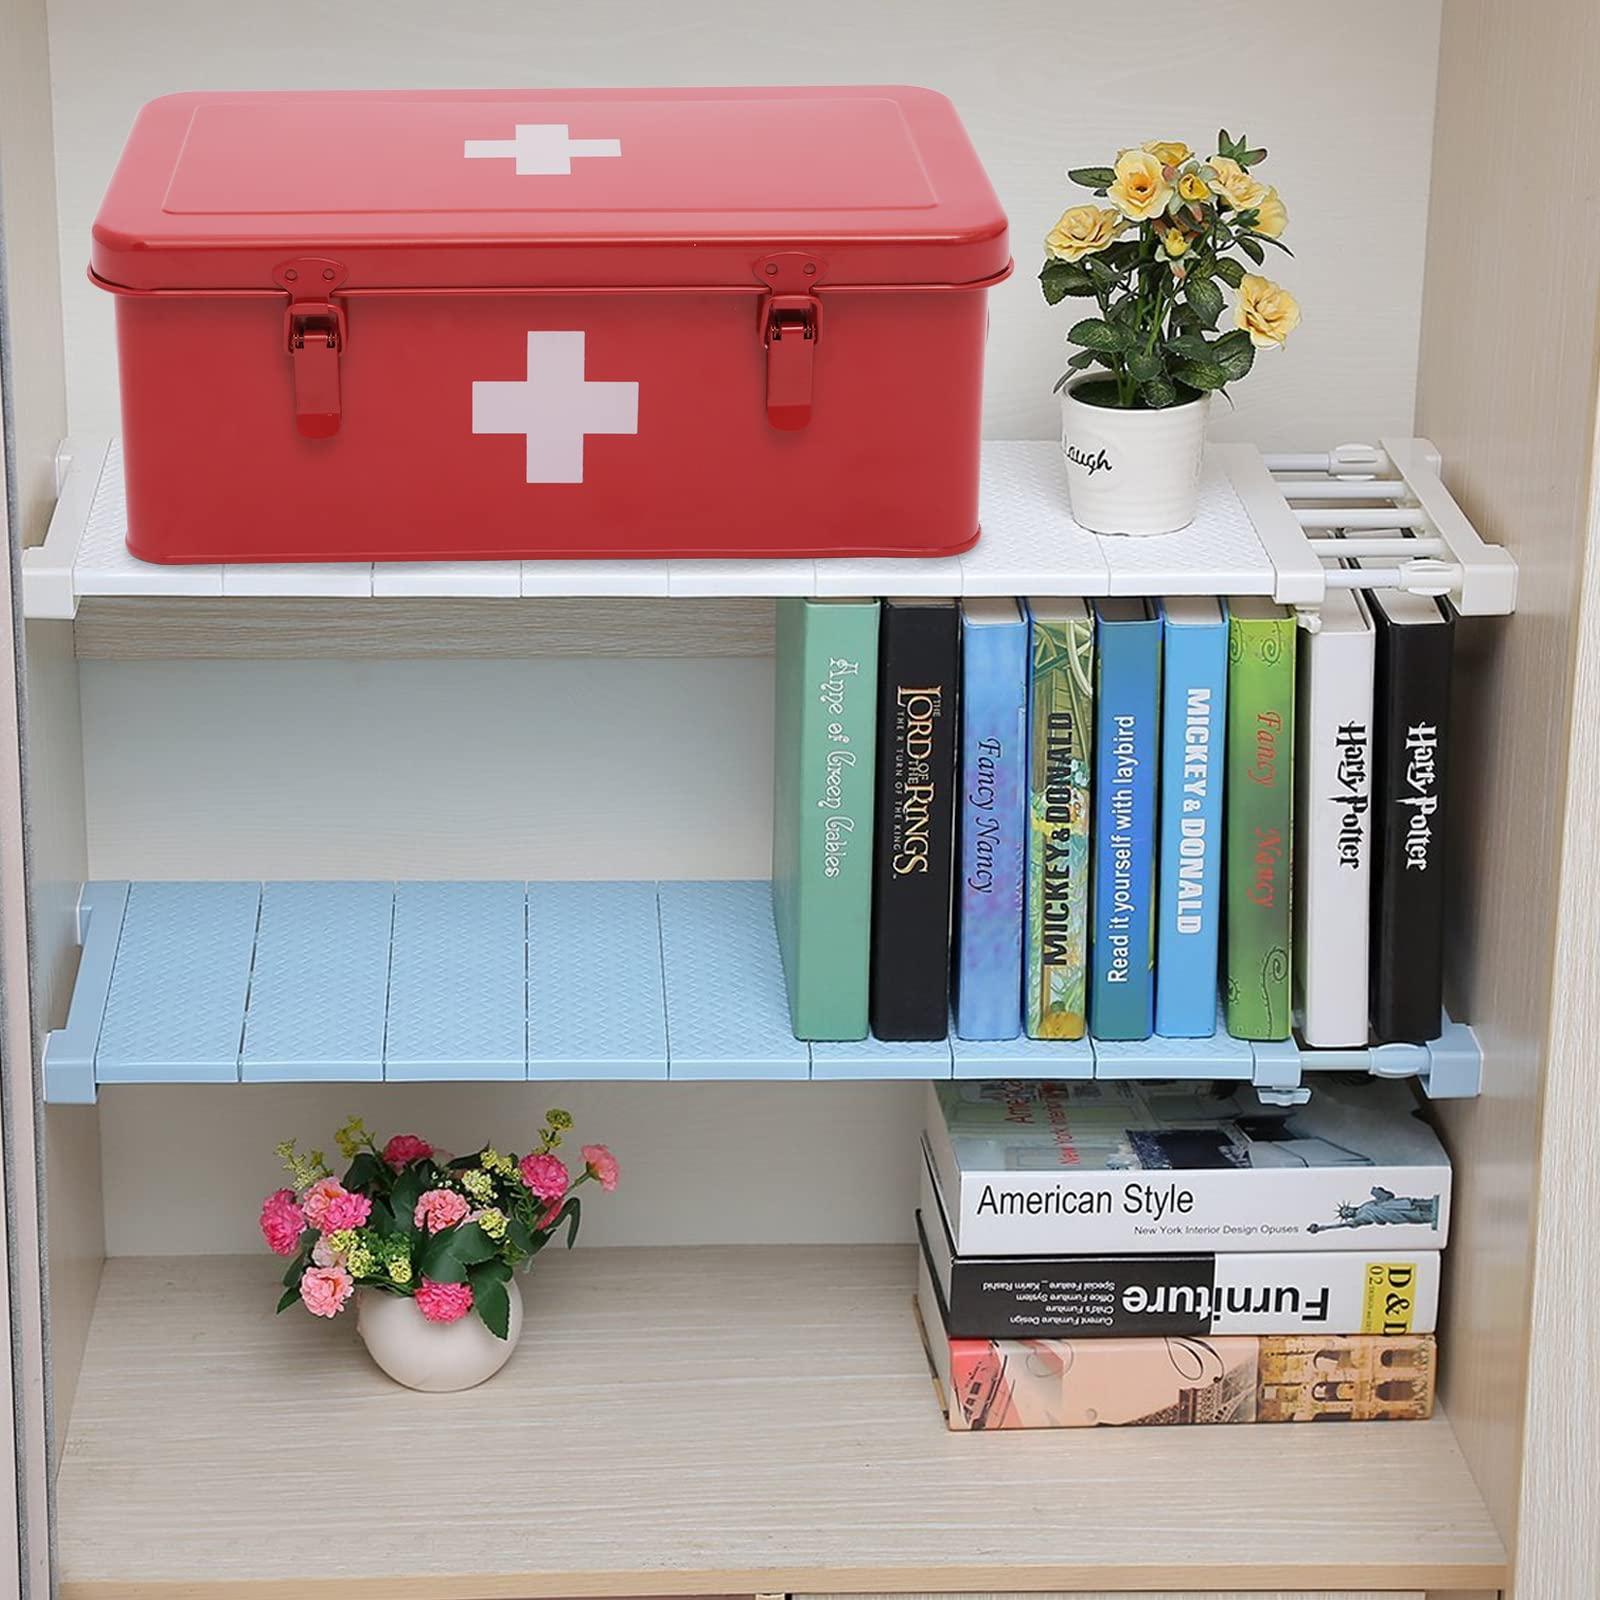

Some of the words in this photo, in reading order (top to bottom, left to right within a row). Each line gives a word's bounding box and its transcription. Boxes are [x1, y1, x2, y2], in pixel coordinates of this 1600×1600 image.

[820, 657, 859, 715] Anne
[896, 711, 905, 730] THE
[932, 699, 942, 717] THE
[827, 723, 849, 743] of
[897, 685, 942, 759] LORD
[1113, 715, 1138, 783] laybird
[1184, 688, 1211, 798] MICKEY
[1248, 711, 1282, 787] Fancy
[1046, 712, 1073, 823] DONALD
[1336, 720, 1368, 793] Harry
[1405, 721, 1438, 794] Harry
[818, 750, 856, 811] Green
[908, 760, 919, 784] THE
[917, 762, 930, 780] OF
[969, 738, 1001, 811] Fancy
[894, 781, 903, 795] OF
[894, 801, 903, 819] THE
[1112, 790, 1132, 830] with
[1183, 799, 1202, 813] &
[893, 782, 935, 874] RINGS
[893, 824, 902, 851] KING
[1051, 828, 1070, 842] &
[1327, 793, 1369, 870] Potter
[1395, 794, 1439, 871] Potter
[824, 815, 855, 878] Gables
[968, 817, 1000, 893] Nancy
[1110, 834, 1135, 912] yourself
[1176, 817, 1206, 934] DONALD
[1044, 844, 1071, 966] MICKEY
[1109, 917, 1129, 929] it
[1108, 935, 1129, 983] Read
[977, 1184, 1112, 1214] American
[1123, 1183, 1194, 1221] Style
[1134, 1226, 1157, 1235] New
[1159, 1226, 1182, 1235] York
[1185, 1225, 1220, 1235] Interior
[1223, 1225, 1257, 1236] Design
[1260, 1225, 1299, 1235] Opuses
[982, 1281, 1013, 1291] Rashid
[1015, 1282, 1040, 1291] Karim
[1016, 1292, 1048, 1303] System
[1048, 1281, 1082, 1291] Feature
[1049, 1293, 1087, 1303] Furniture
[1084, 1281, 1116, 1291] Special
[1089, 1293, 1115, 1303] Office
[1045, 1305, 1083, 1315] Furniture
[1085, 1305, 1115, 1315] Child's
[1122, 1285, 1330, 1322] Furniture
[1010, 1315, 1040, 1325] Design
[1041, 1315, 1080, 1325] Furniture
[1081, 1316, 1114, 1326] Current
